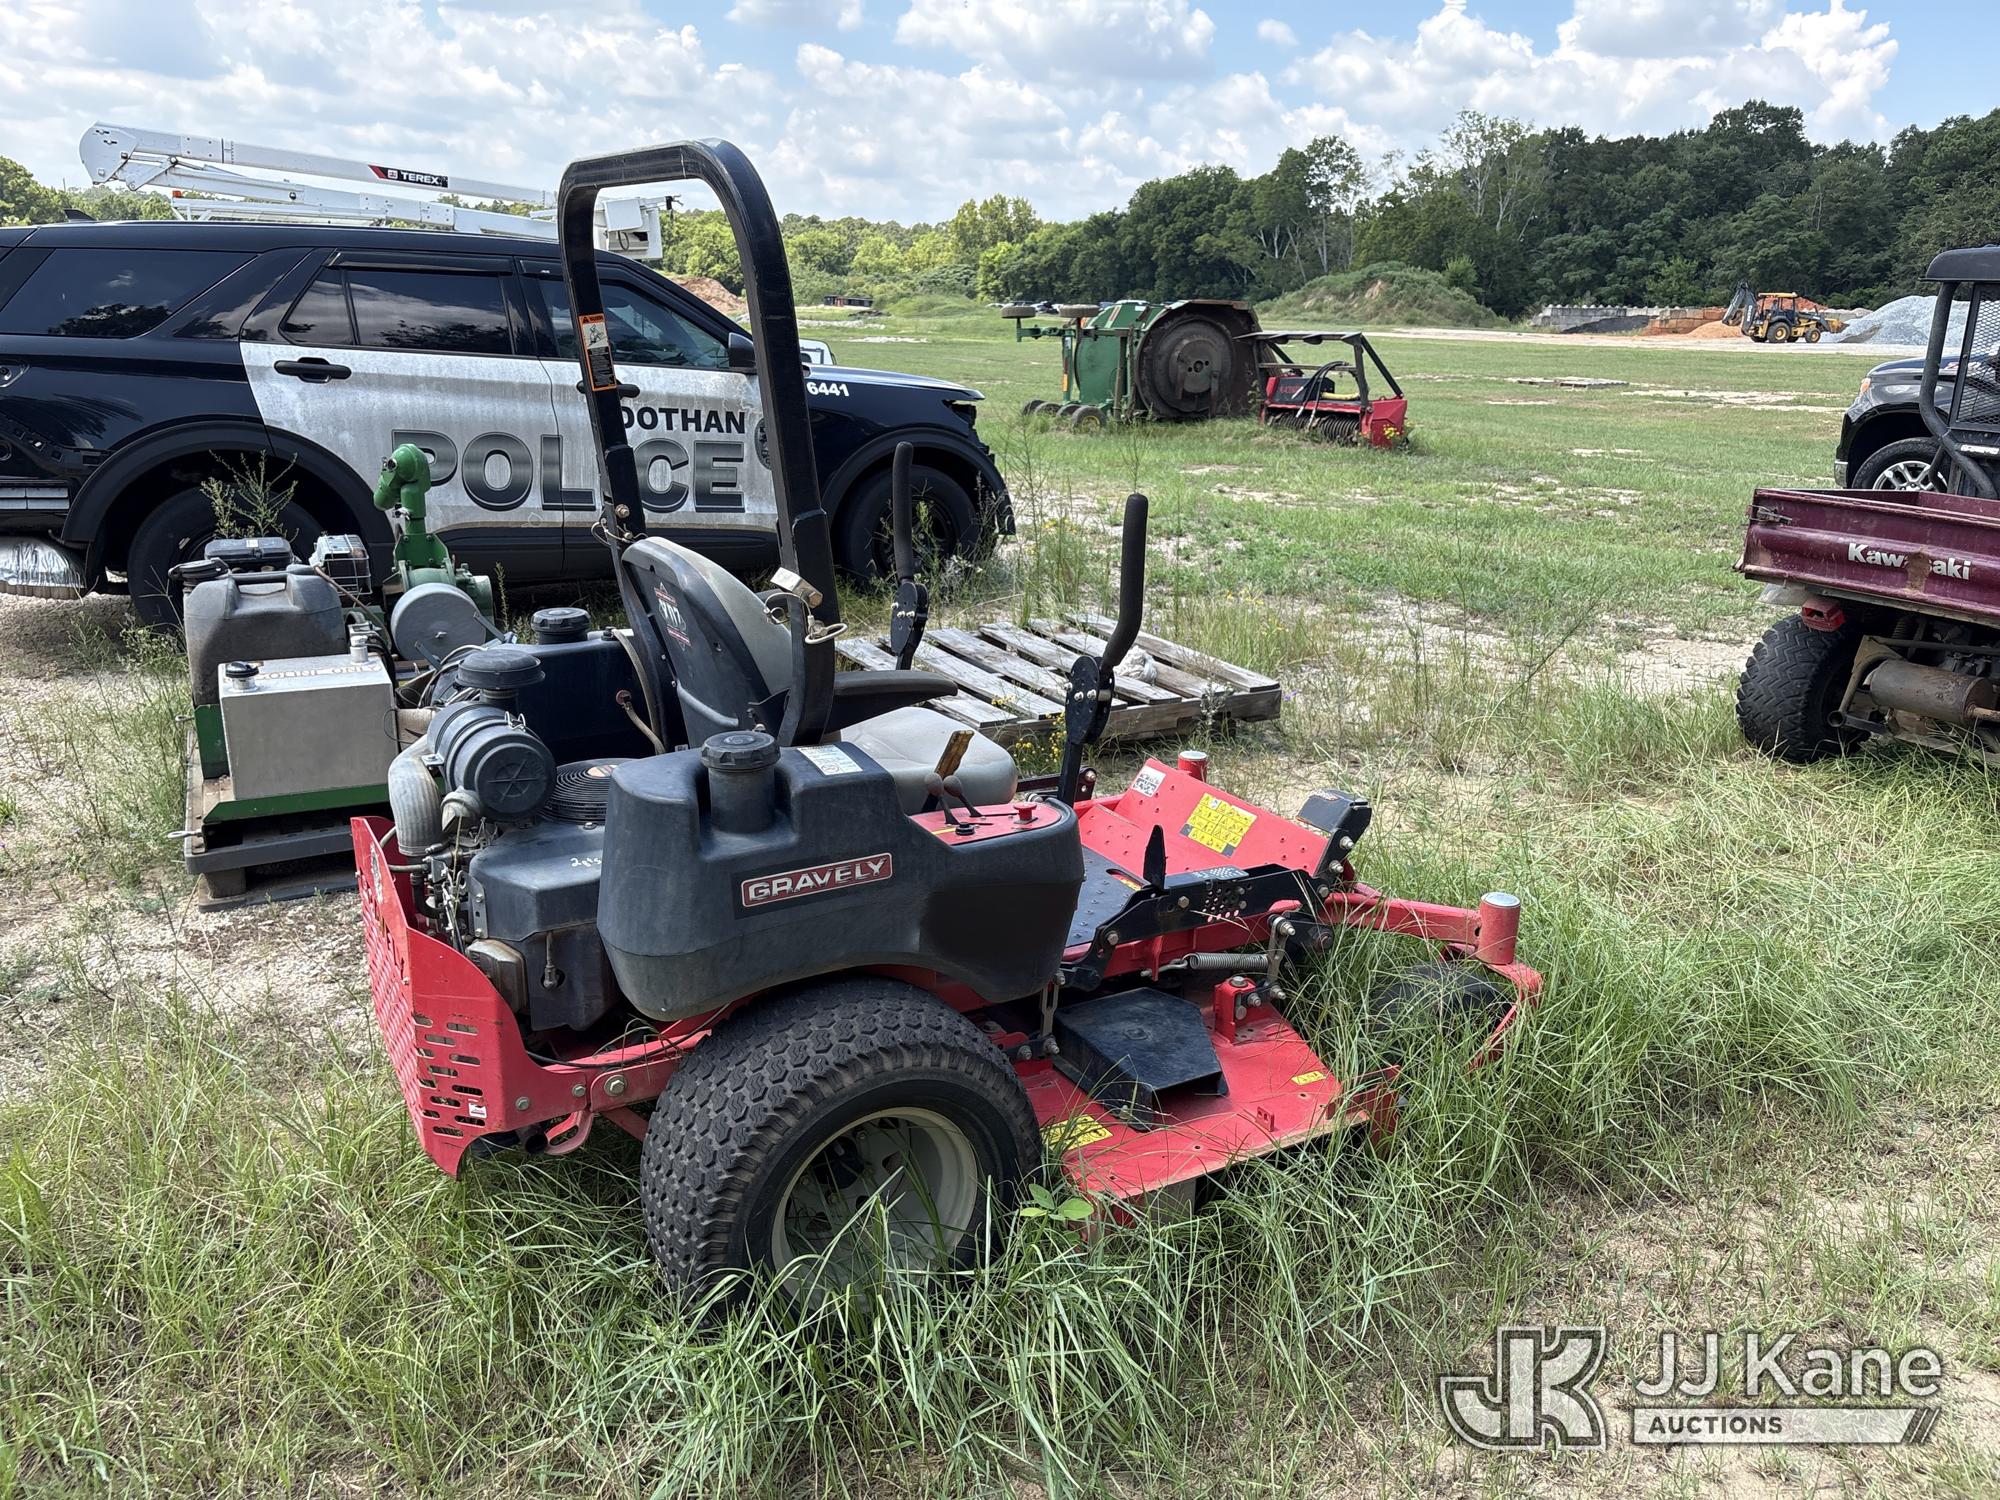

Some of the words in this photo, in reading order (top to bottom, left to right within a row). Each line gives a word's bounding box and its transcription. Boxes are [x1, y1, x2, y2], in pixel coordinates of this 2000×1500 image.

[400, 170, 440, 185] TEREX
[806, 381, 849, 397] 6441
[391, 429, 746, 514] POLCE
[1848, 543, 1971, 580] Kawaki
[749, 857, 886, 901] GRAVELY
